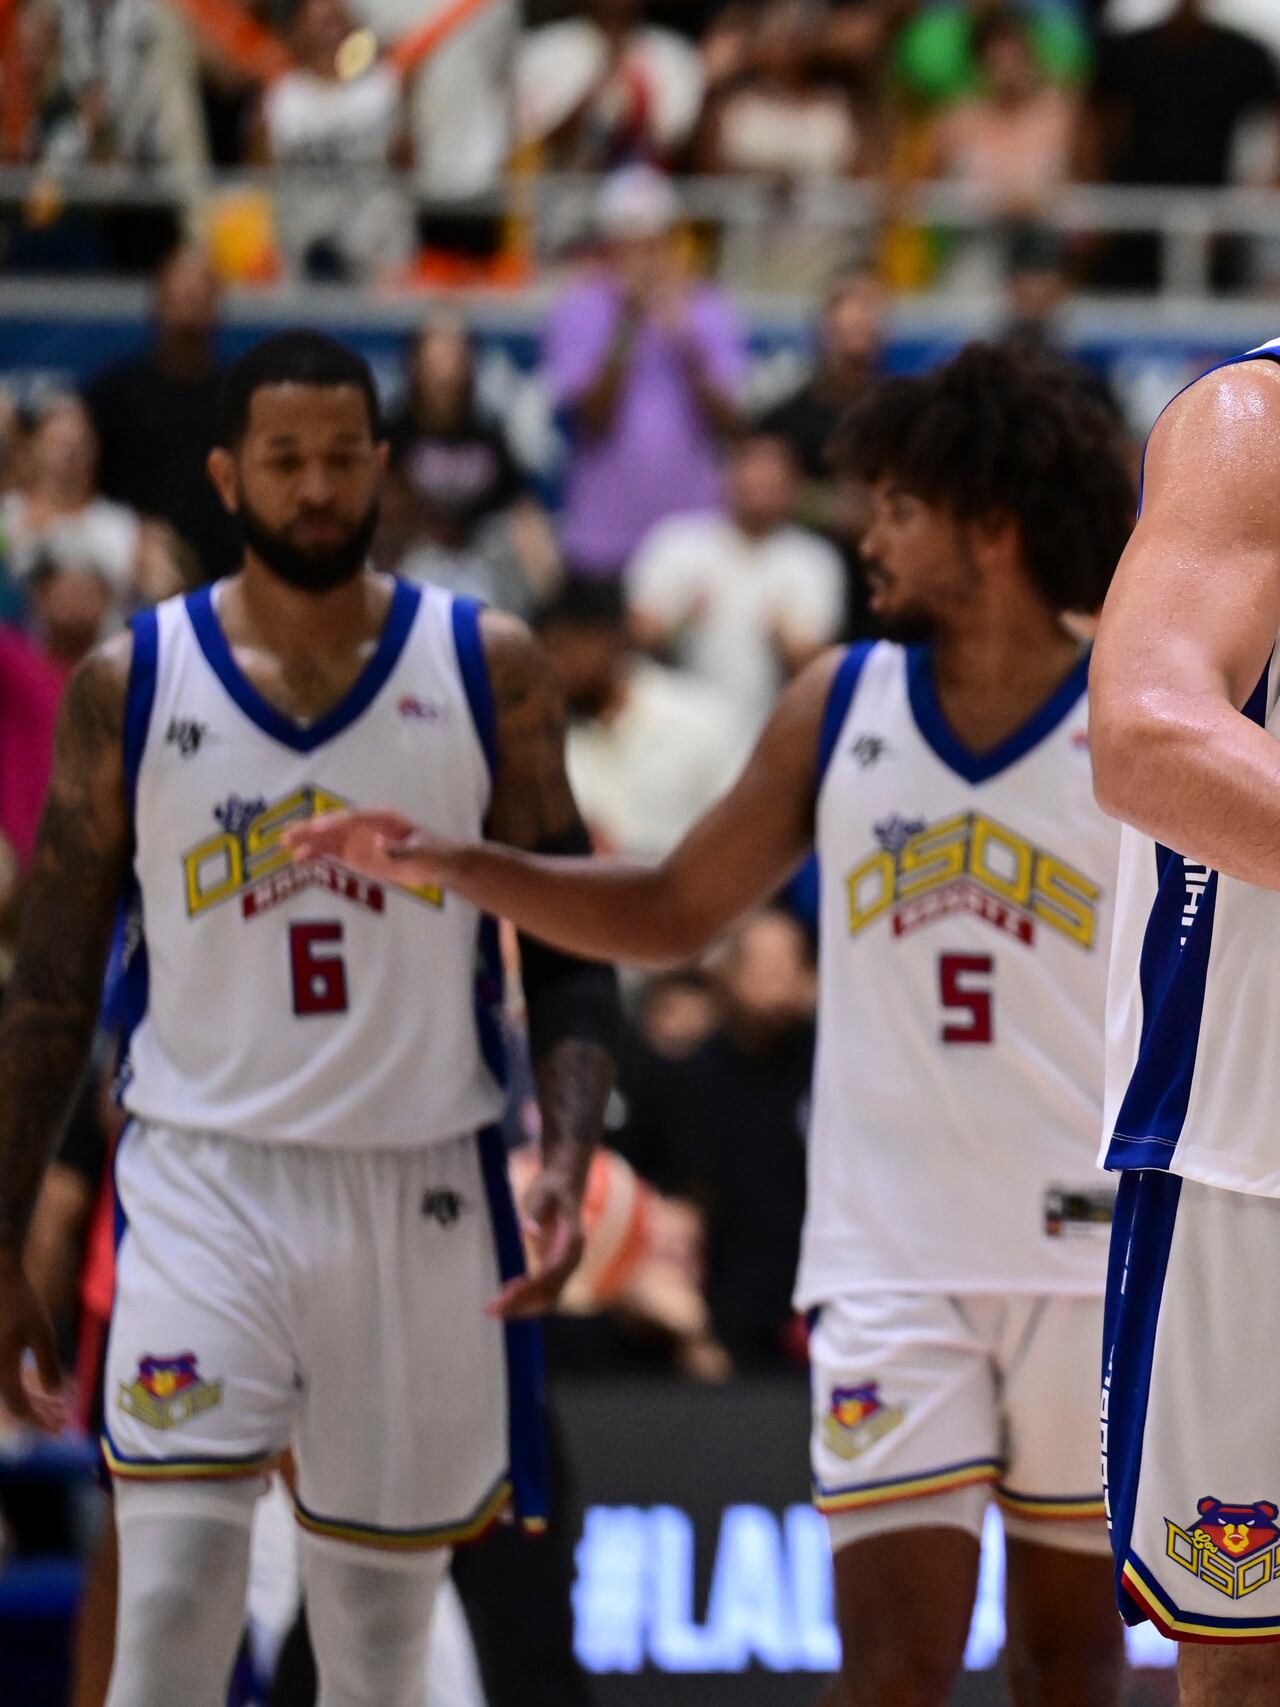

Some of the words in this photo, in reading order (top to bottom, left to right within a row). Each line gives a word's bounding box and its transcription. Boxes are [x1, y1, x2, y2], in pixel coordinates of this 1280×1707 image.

[844, 811, 1104, 950] OSOS
[290, 920, 347, 1016] 6
[938, 952, 993, 1044] 5
